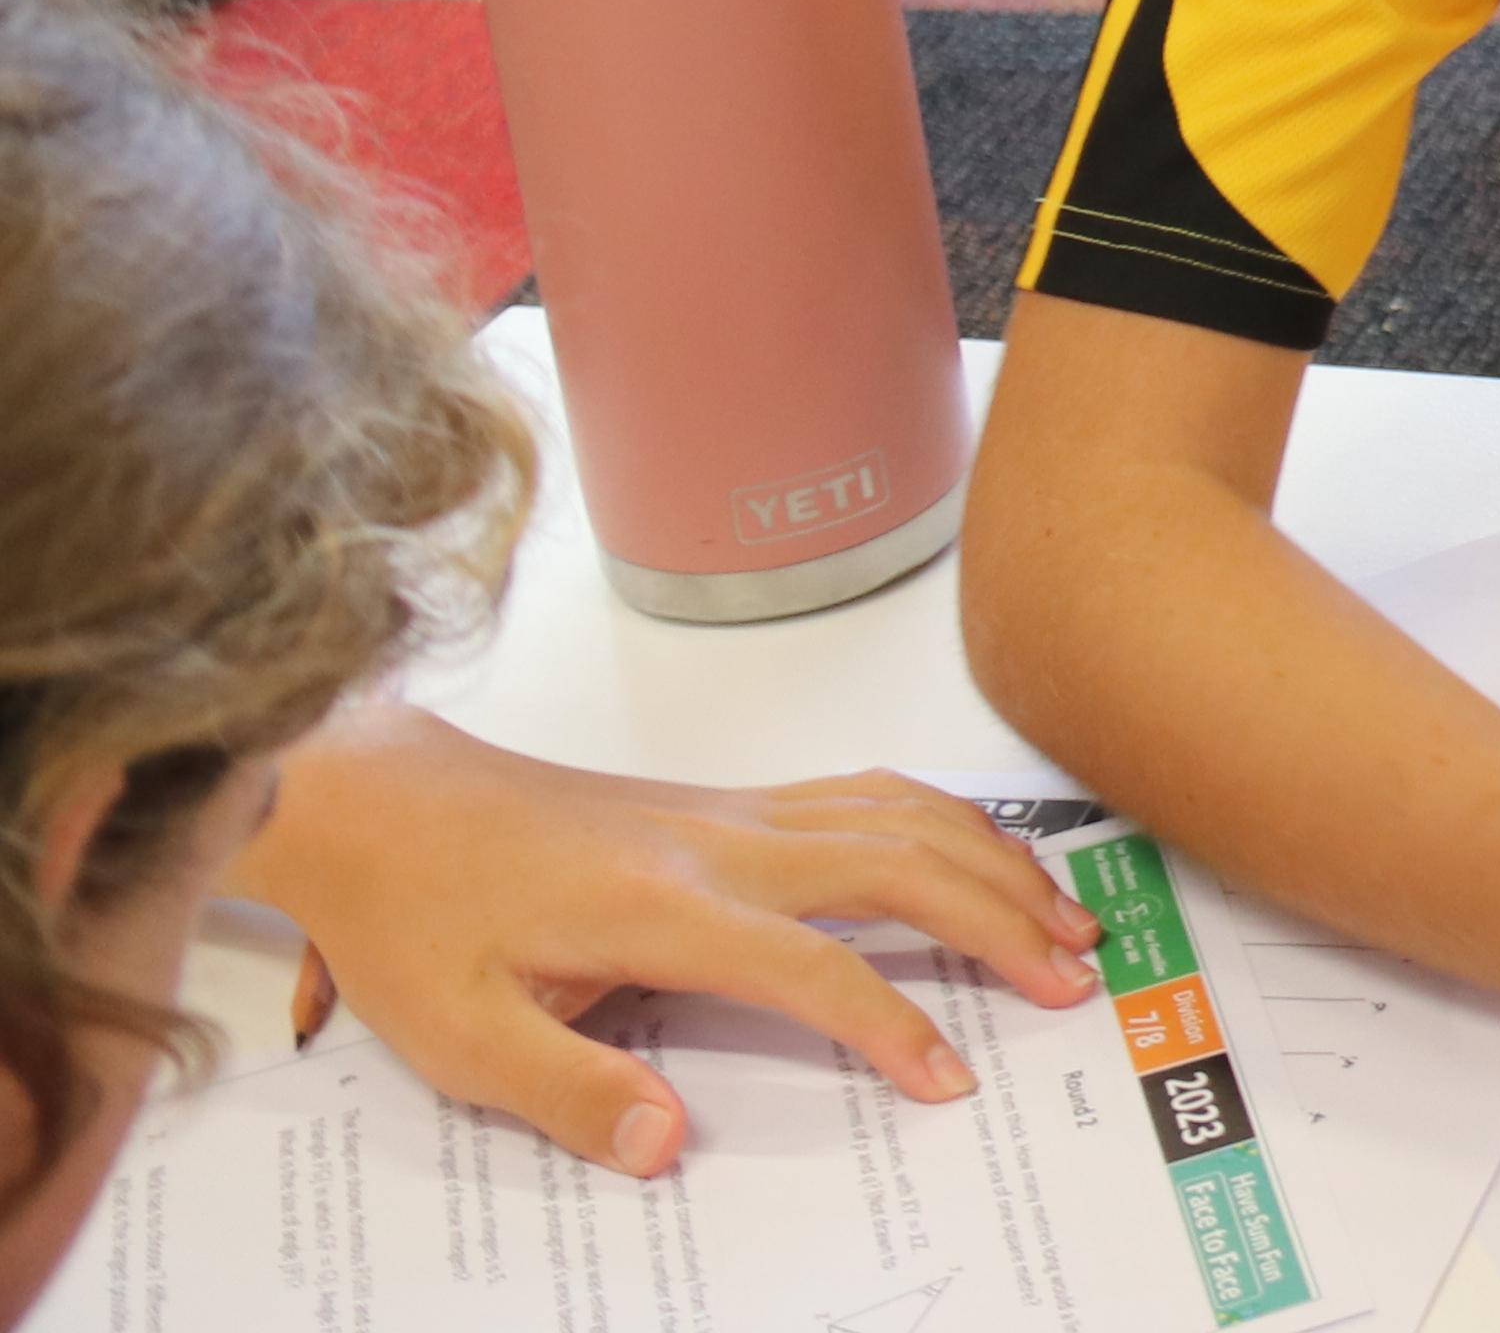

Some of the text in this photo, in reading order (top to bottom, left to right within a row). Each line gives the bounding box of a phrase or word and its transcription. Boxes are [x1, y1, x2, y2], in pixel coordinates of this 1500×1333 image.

[746, 465, 875, 530] YETI
[1123, 1010, 1165, 1050] 7/8
[1171, 989, 1205, 1045] Division
[1062, 1071, 1097, 1129] Round 2
[1163, 1070, 1225, 1147] 2023
[1184, 1180, 1248, 1302] Face to Face
[1230, 1172, 1287, 1283] Have Sum Fun
